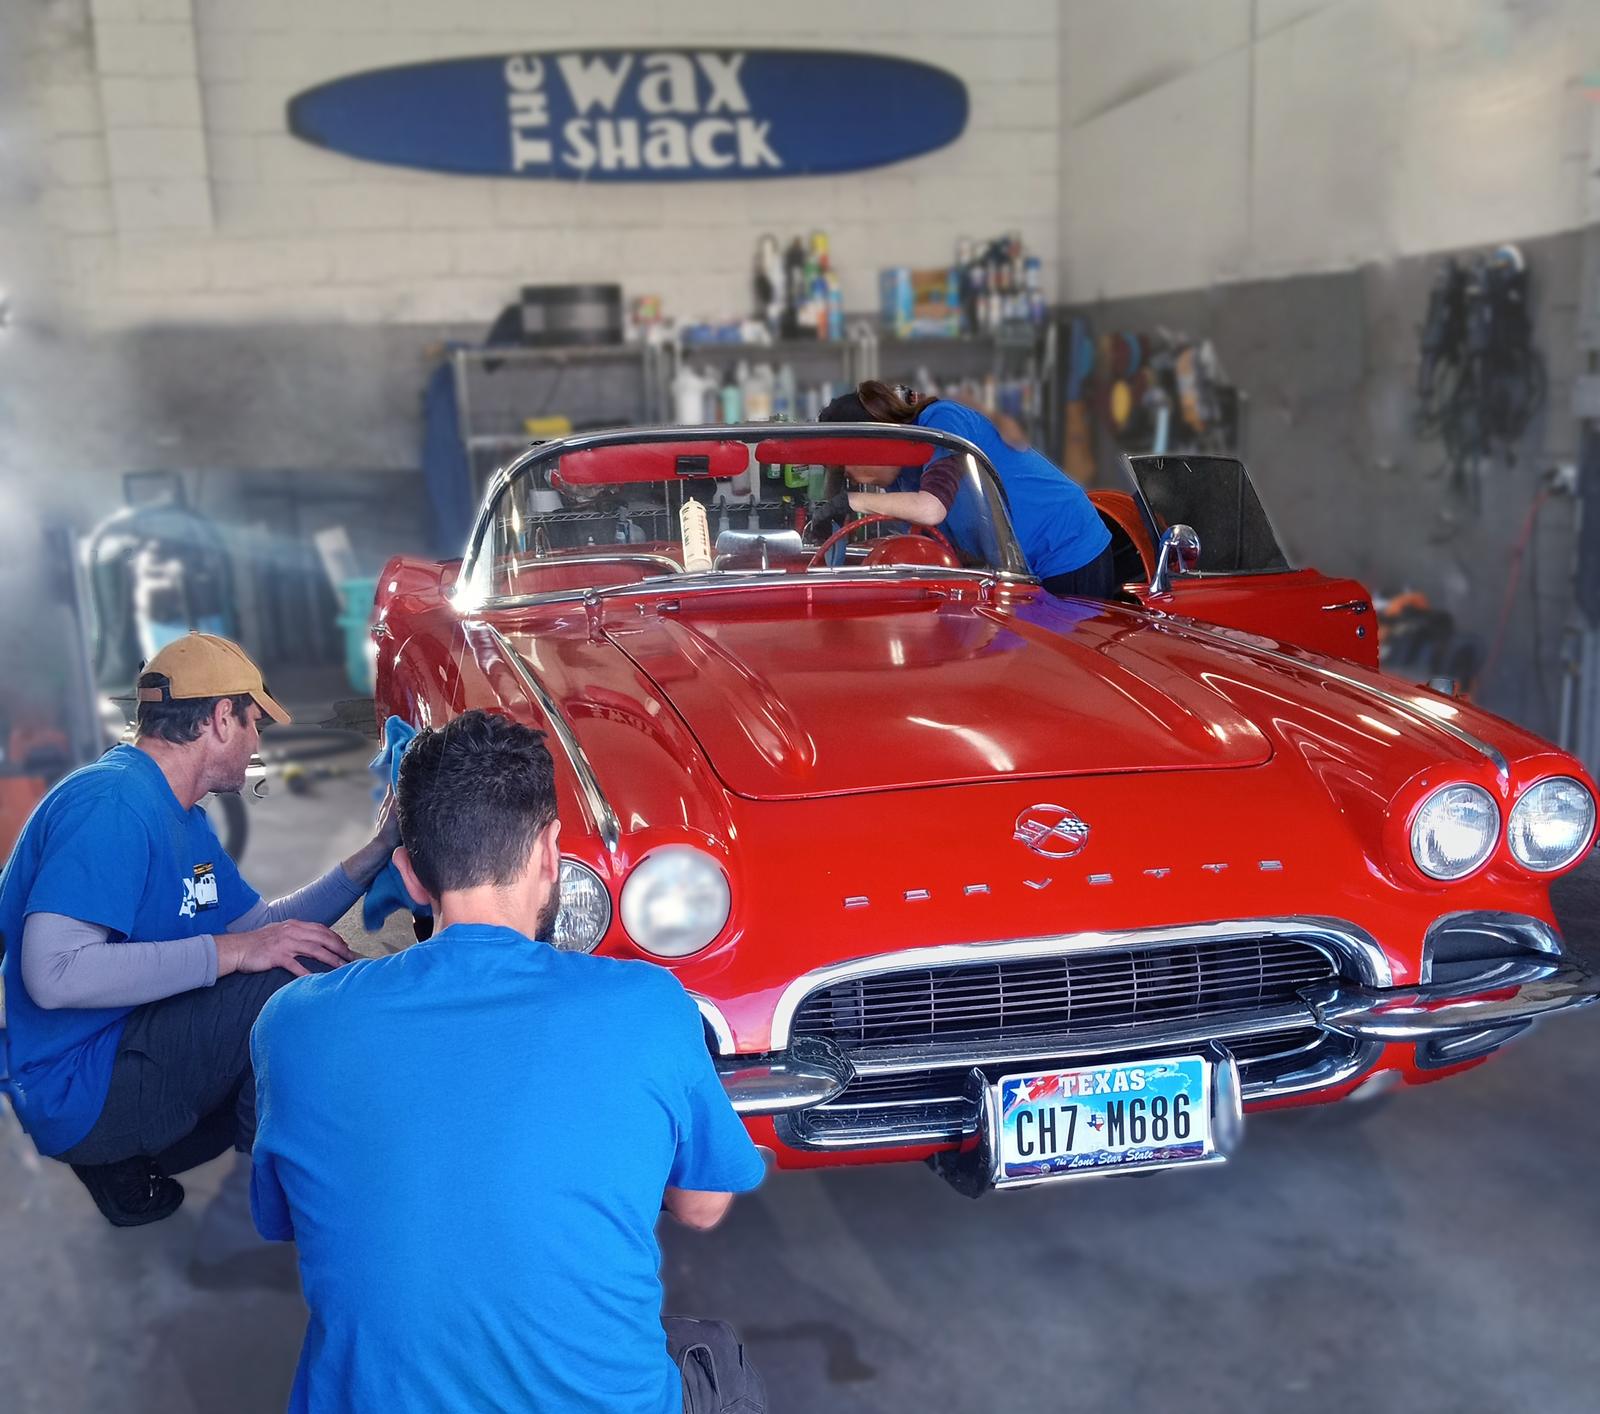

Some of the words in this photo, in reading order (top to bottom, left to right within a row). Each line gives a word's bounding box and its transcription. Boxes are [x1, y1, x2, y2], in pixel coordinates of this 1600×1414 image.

[1058, 1068, 1147, 1098] TEXAS
[1016, 1105, 1078, 1156] CH7
[1107, 1093, 1191, 1147] M686
[1068, 1155, 1095, 1168] Lone
[1098, 1152, 1122, 1164] Star
[1125, 1149, 1154, 1162] State
